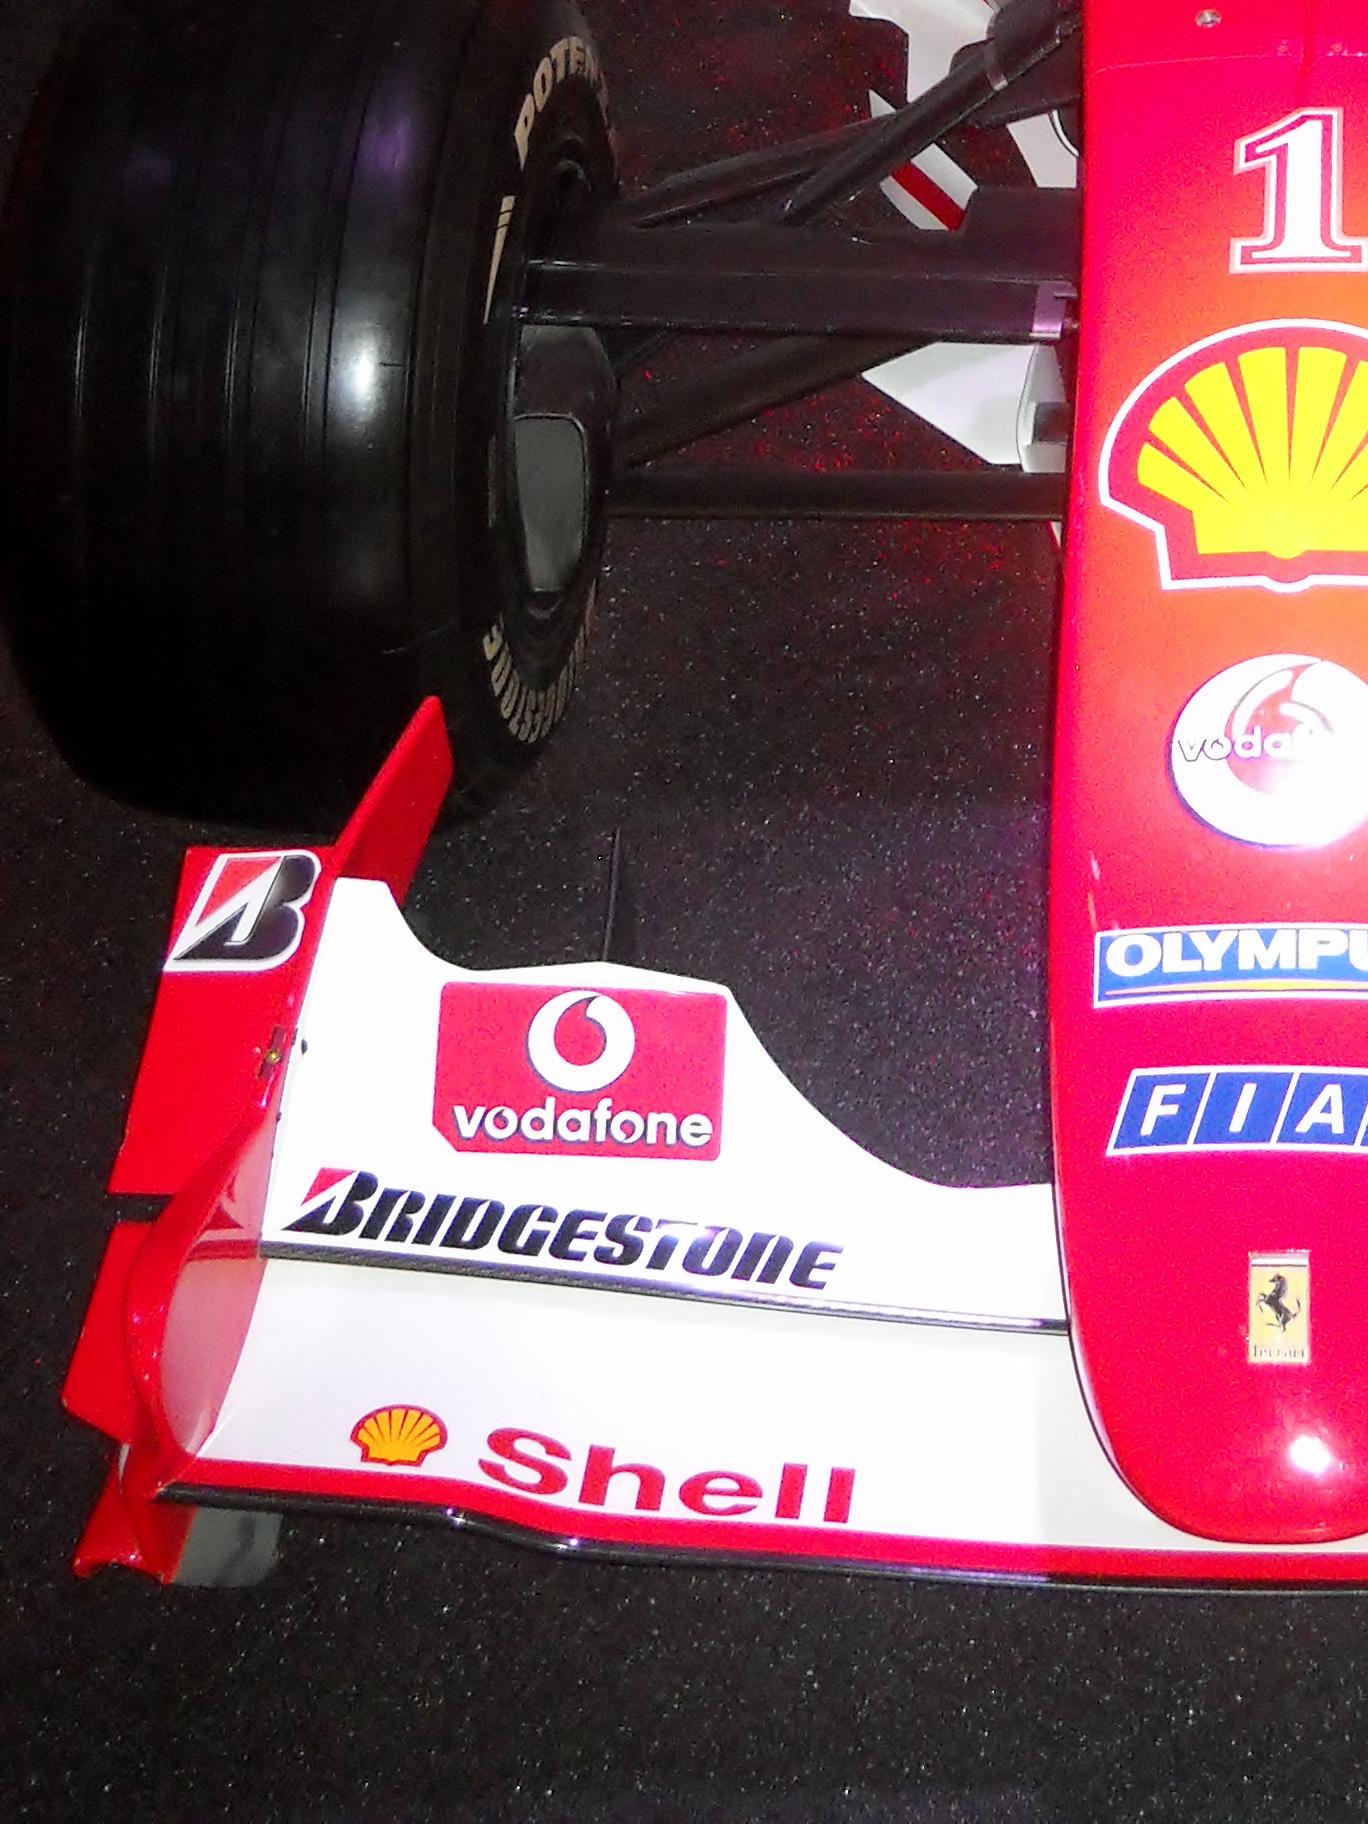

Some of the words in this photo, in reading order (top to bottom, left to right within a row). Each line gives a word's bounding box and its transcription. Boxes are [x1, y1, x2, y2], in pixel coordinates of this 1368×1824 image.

[452, 1096, 715, 1149] vodafone
[281, 1168, 844, 1291] BRIDGESTONE
[477, 1426, 857, 1524] Shell
